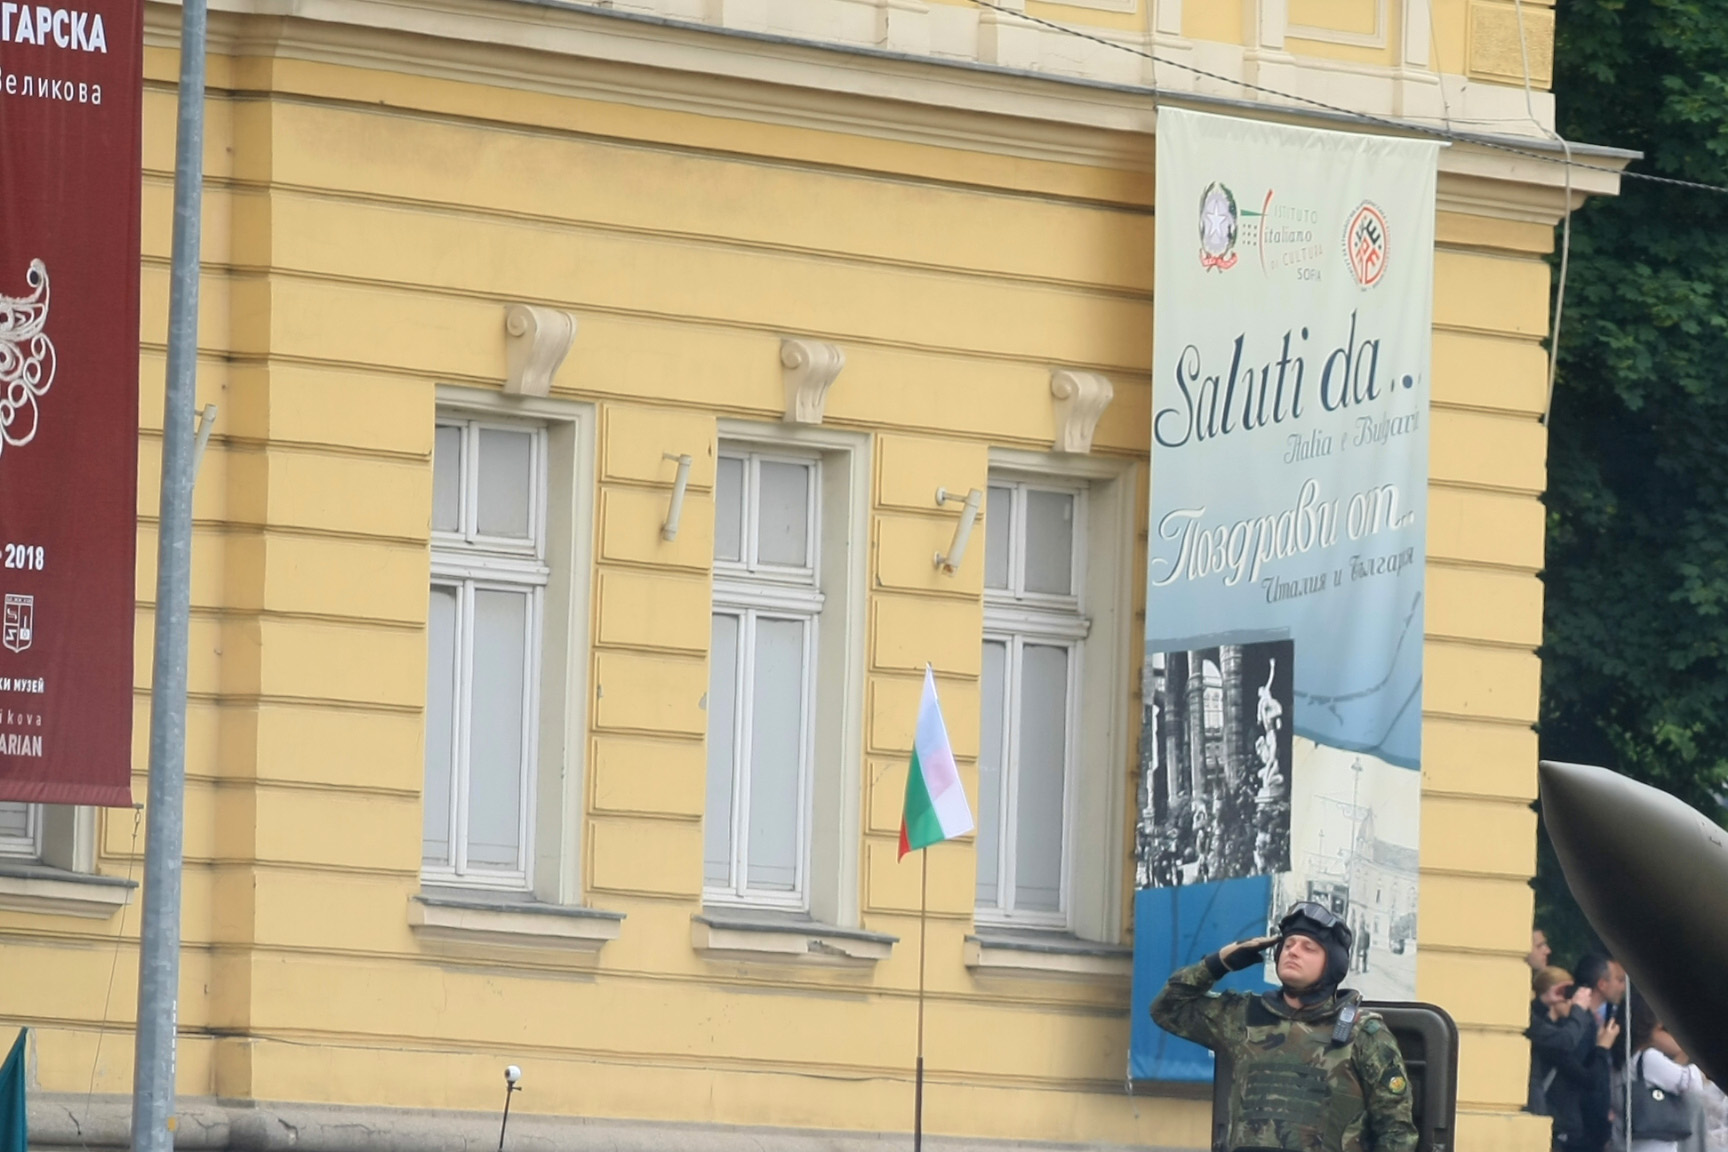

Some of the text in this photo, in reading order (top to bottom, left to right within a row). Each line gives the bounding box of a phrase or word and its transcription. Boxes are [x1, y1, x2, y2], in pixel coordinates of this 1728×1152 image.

[1, 1, 108, 54] ГАРСКА
[1264, 226, 1313, 244] italiano
[1154, 326, 1309, 448] Saluti
[1283, 429, 1333, 464] Italia
[1152, 478, 1339, 587] Поздрави
[5, 543, 45, 571] 2018
[1261, 573, 1328, 604] Италия
[1334, 569, 1343, 587] и
[14, 677, 45, 694] МУЗЕЙ
